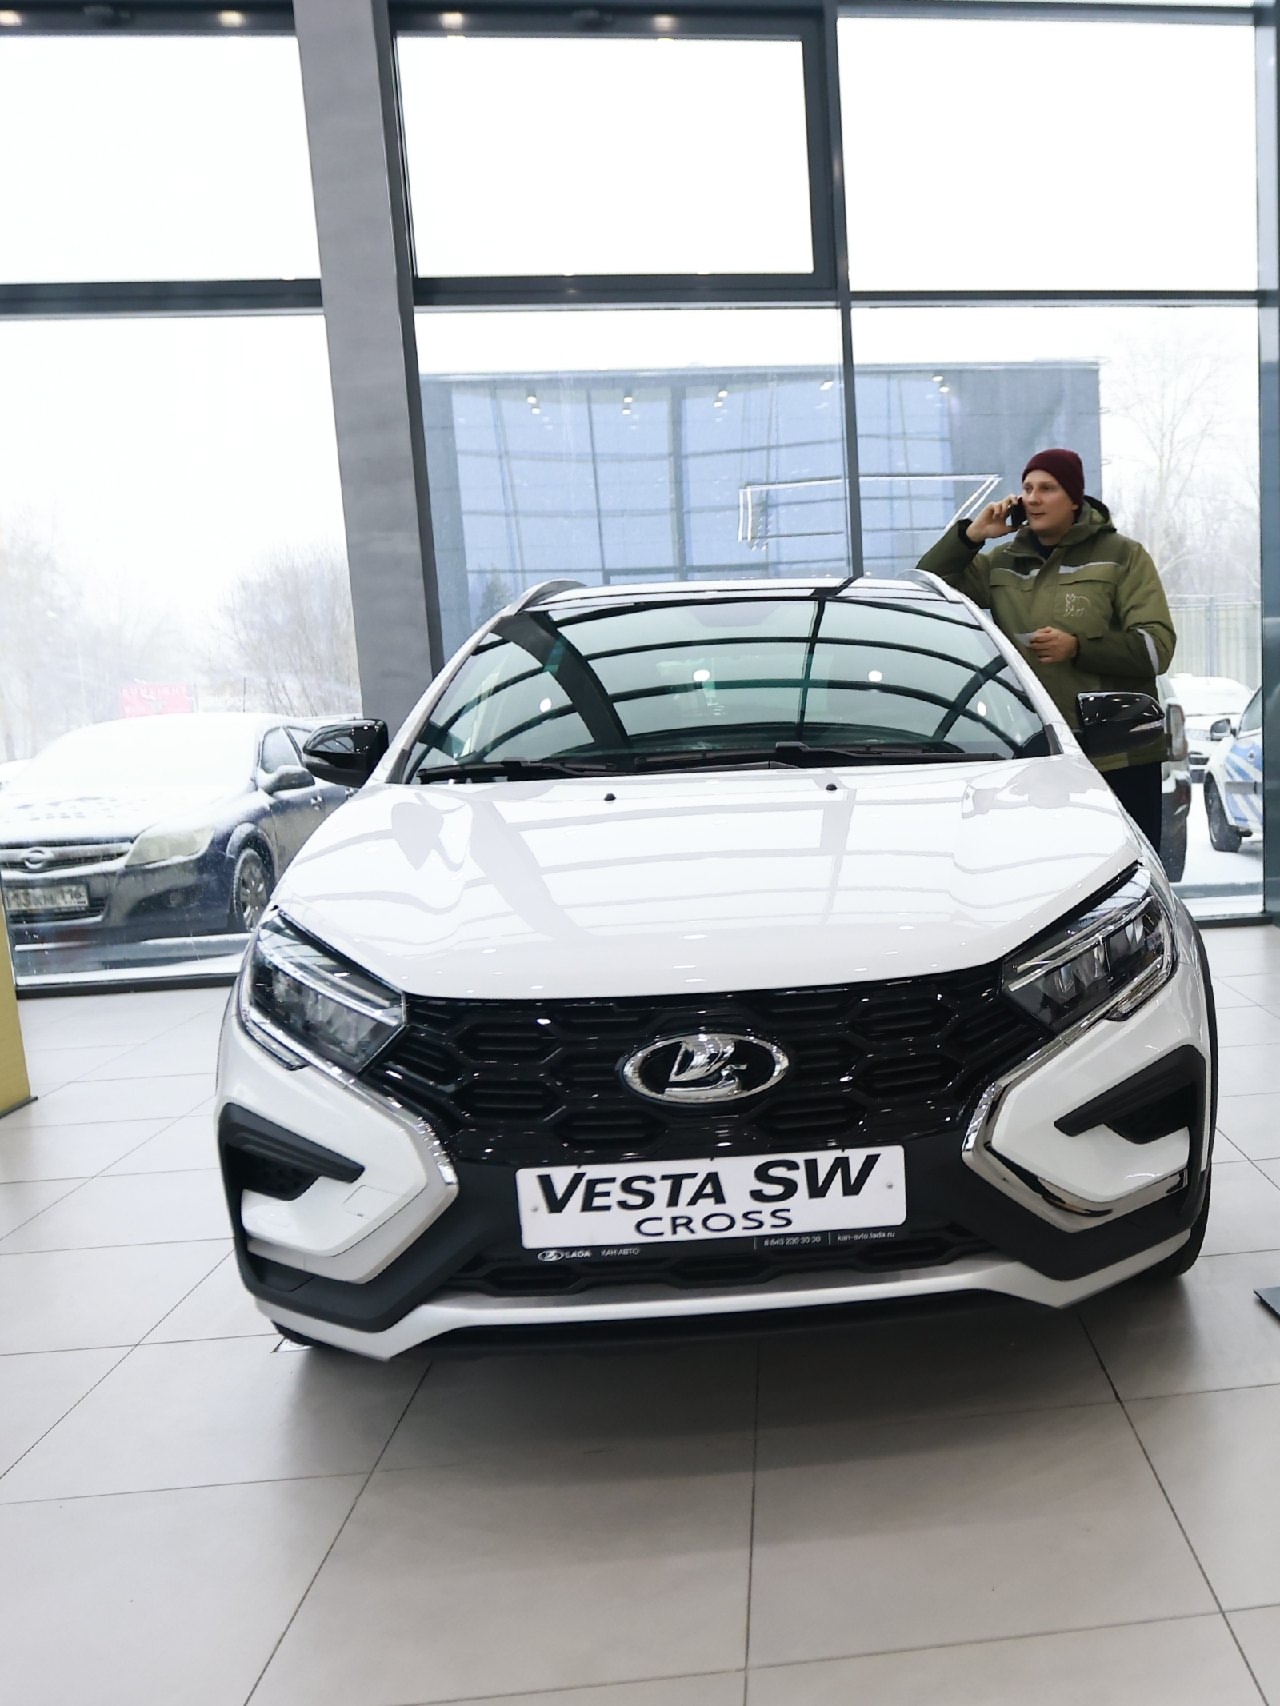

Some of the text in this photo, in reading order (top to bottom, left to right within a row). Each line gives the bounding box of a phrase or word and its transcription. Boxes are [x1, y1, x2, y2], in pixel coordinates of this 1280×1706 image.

[537, 1153, 881, 1214] VESTA SW
[634, 1208, 793, 1237] CROSS
[565, 1249, 592, 1259] LADA
